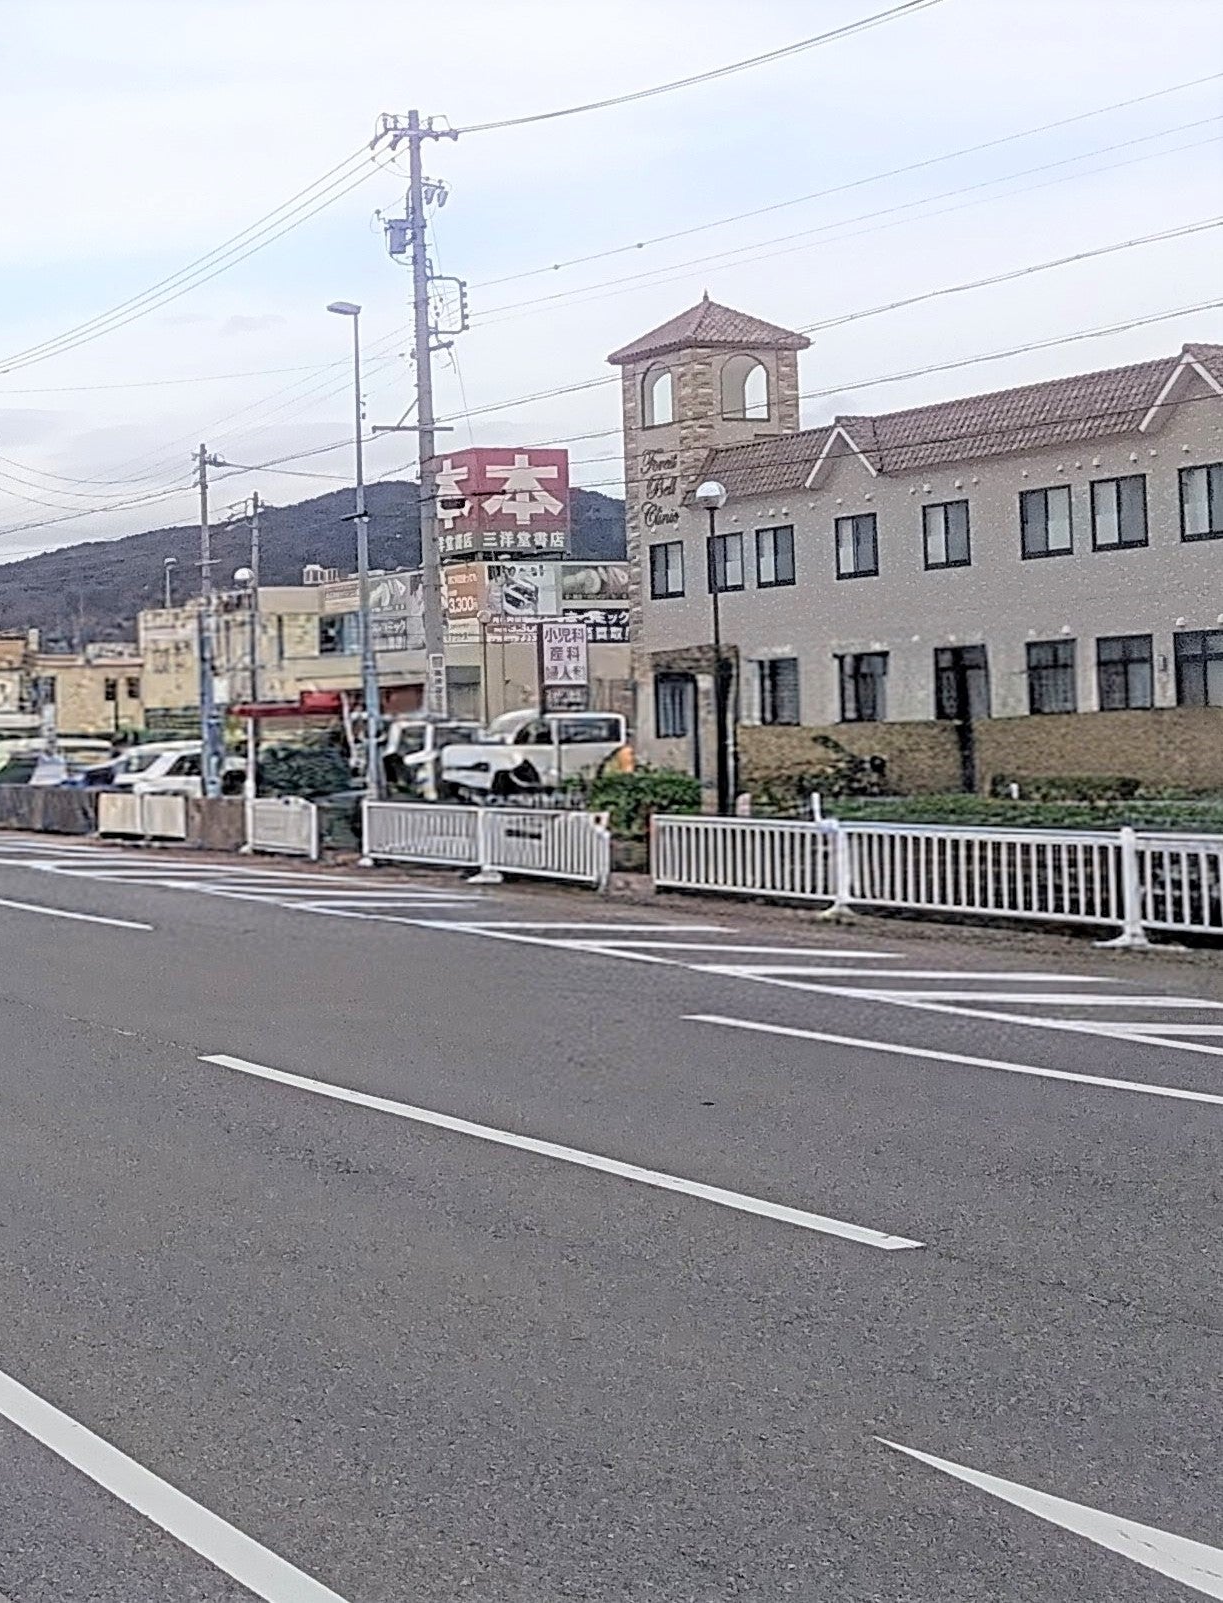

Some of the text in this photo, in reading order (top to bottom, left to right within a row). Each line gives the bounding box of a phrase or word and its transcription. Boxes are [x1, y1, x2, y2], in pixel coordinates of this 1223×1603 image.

[481, 454, 564, 525] 本
[482, 531, 566, 548] 三洋堂書店
[544, 627, 585, 643] 小児科
[549, 645, 580, 661] 産科
